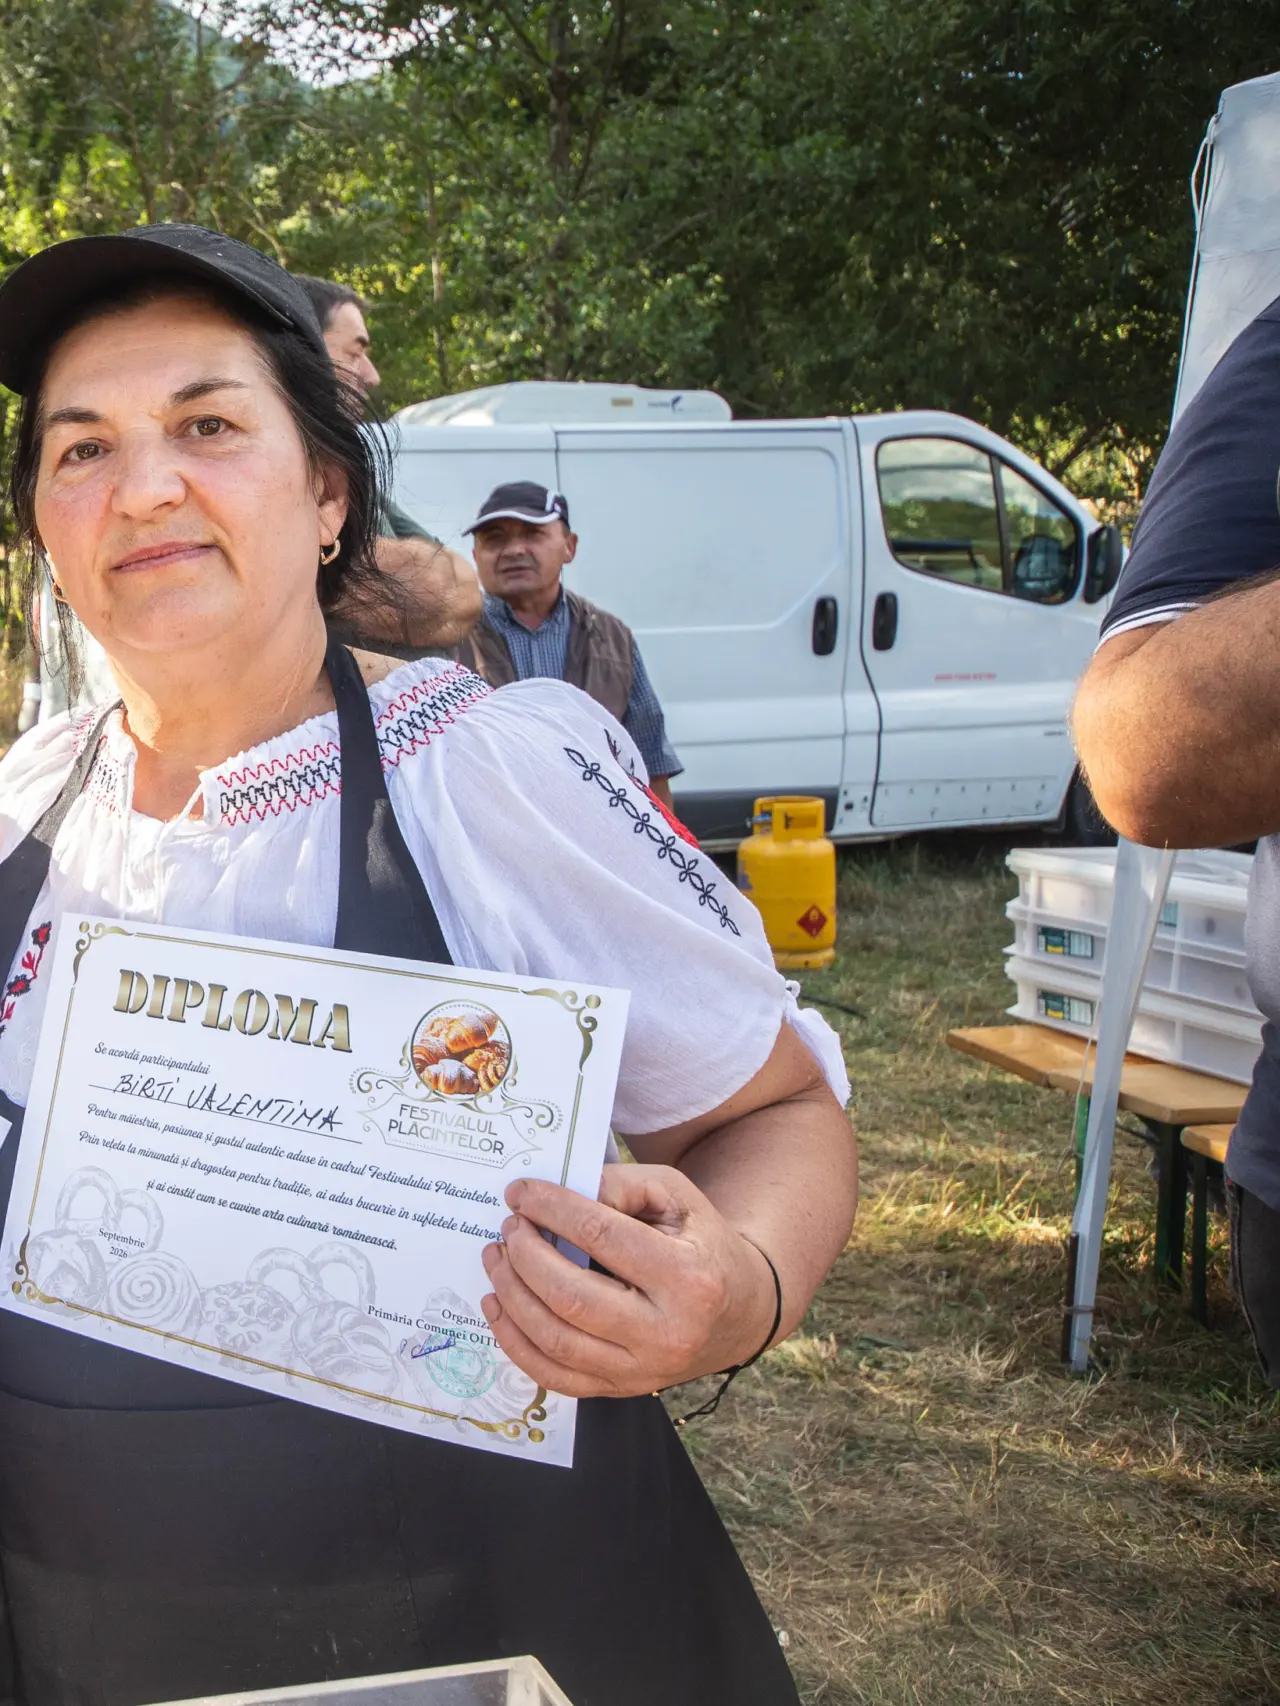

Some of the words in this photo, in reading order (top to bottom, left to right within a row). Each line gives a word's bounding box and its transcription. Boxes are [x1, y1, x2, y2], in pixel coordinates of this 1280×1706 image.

[113, 969, 354, 1054] DIPLOMA
[94, 1042, 108, 1055] Se
[108, 1049, 140, 1061] acordă
[138, 1055, 211, 1075] participantului
[387, 1118, 505, 1156] PLĂCINTELOR
[399, 1103, 498, 1137] FESTIVALUL
[87, 1103, 118, 1120] Pentru
[118, 1114, 161, 1131] măiestria,
[161, 1124, 204, 1140] pasiunea
[204, 1132, 215, 1147] și
[212, 1136, 246, 1149] gustul
[245, 1142, 286, 1158] autentic
[286, 1150, 317, 1165] aduse
[317, 1156, 329, 1168] în
[330, 1161, 368, 1176] cadrul
[368, 1165, 433, 1191] Festivalului
[435, 1180, 501, 1207] Plăcintelor.
[79, 1130, 100, 1146] Prin
[102, 1138, 126, 1152] rețeta
[137, 1148, 180, 1165] minunată
[180, 1157, 191, 1169] și
[190, 1158, 237, 1179] dragostea
[236, 1172, 272, 1187] pentru
[315, 1189, 329, 1200] ai
[328, 1192, 354, 1206] adus
[355, 1196, 397, 1216] bucurie
[398, 1207, 410, 1220] în
[411, 1212, 458, 1231] sufletele
[459, 1221, 502, 1241] tuturor
[146, 1179, 156, 1191] și
[155, 1182, 167, 1192] ai
[166, 1184, 196, 1200] cinstit
[196, 1193, 216, 1205] cum
[217, 1198, 229, 1208] se
[229, 1201, 262, 1216] cuvine
[262, 1209, 285, 1222] arta
[286, 1214, 330, 1233] culinară
[332, 1225, 398, 1251] românească.
[99, 1228, 146, 1249] Septembrie
[109, 1246, 128, 1259] 2026
[368, 1305, 413, 1327] Primăria
[415, 1319, 467, 1341] Comunei
[469, 1332, 503, 1349] OITU
[441, 1309, 493, 1331] Organiz
